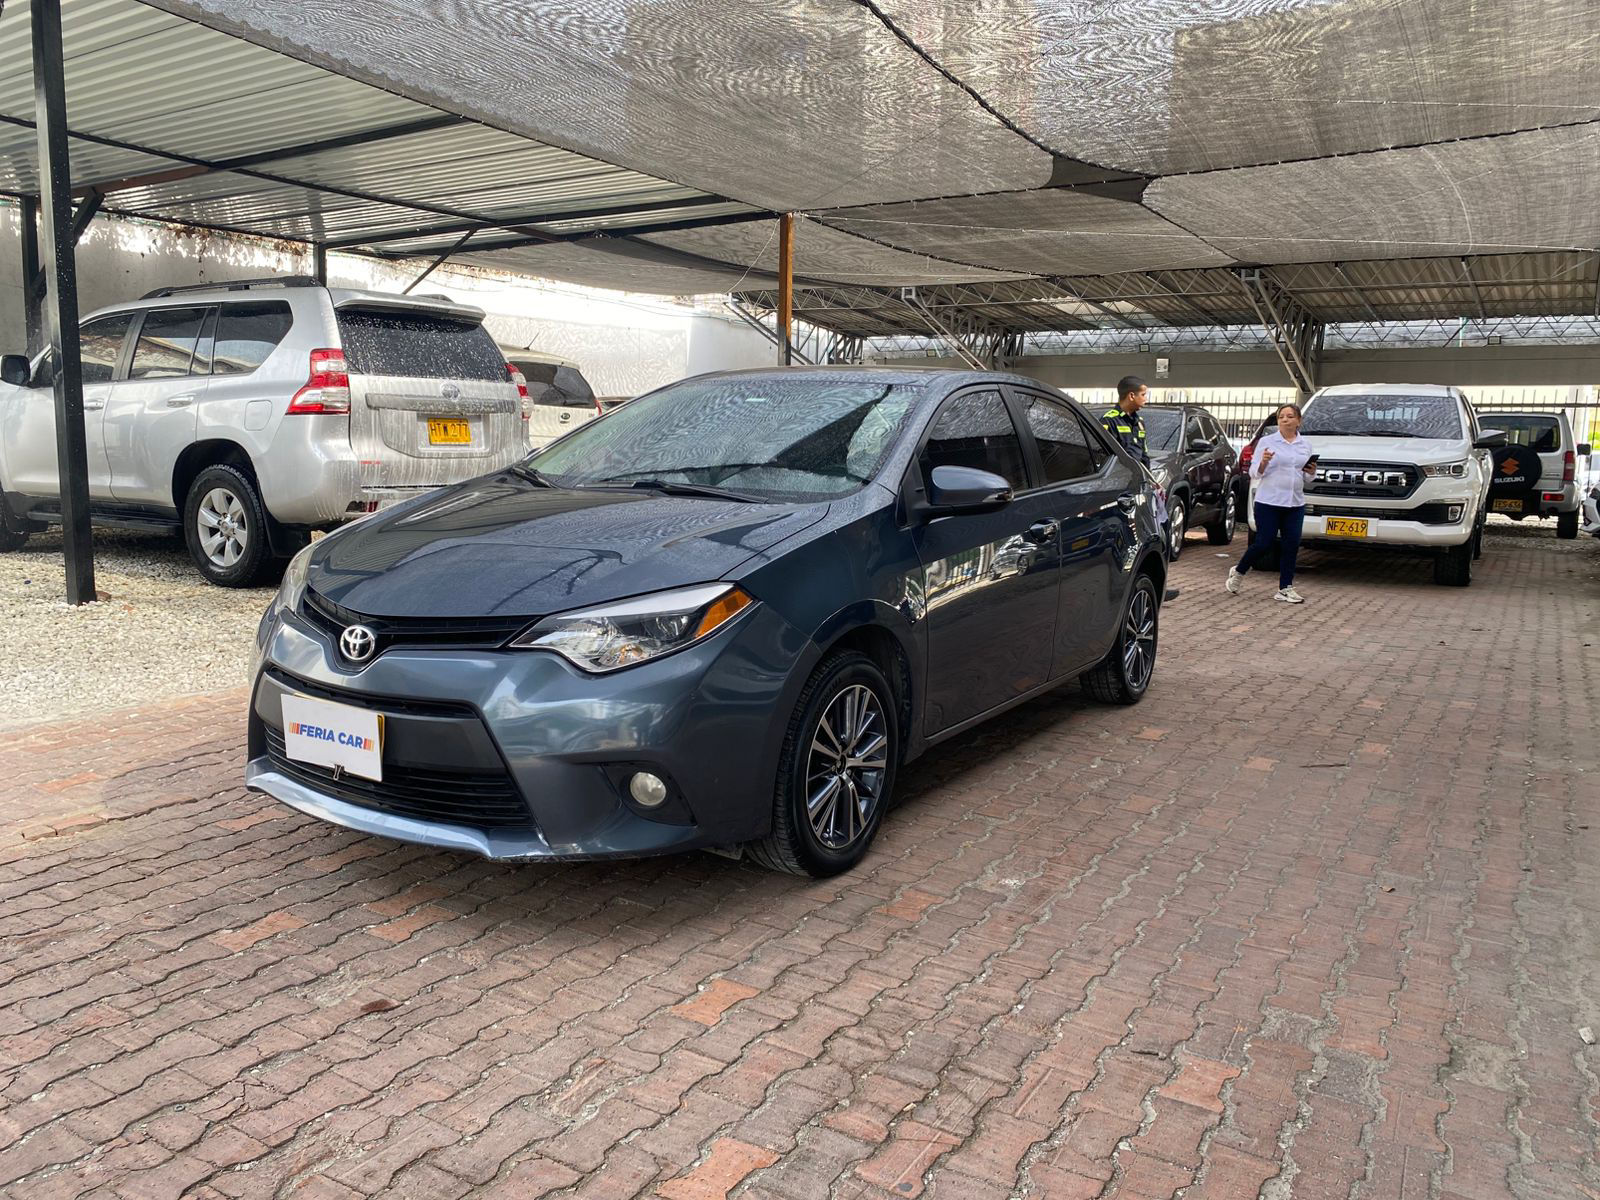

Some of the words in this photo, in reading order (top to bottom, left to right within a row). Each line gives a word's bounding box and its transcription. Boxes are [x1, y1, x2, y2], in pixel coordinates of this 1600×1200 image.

[1494, 476, 1525, 484] SUZUKI
[300, 724, 335, 742] FERIA
[338, 732, 363, 749] CAR
